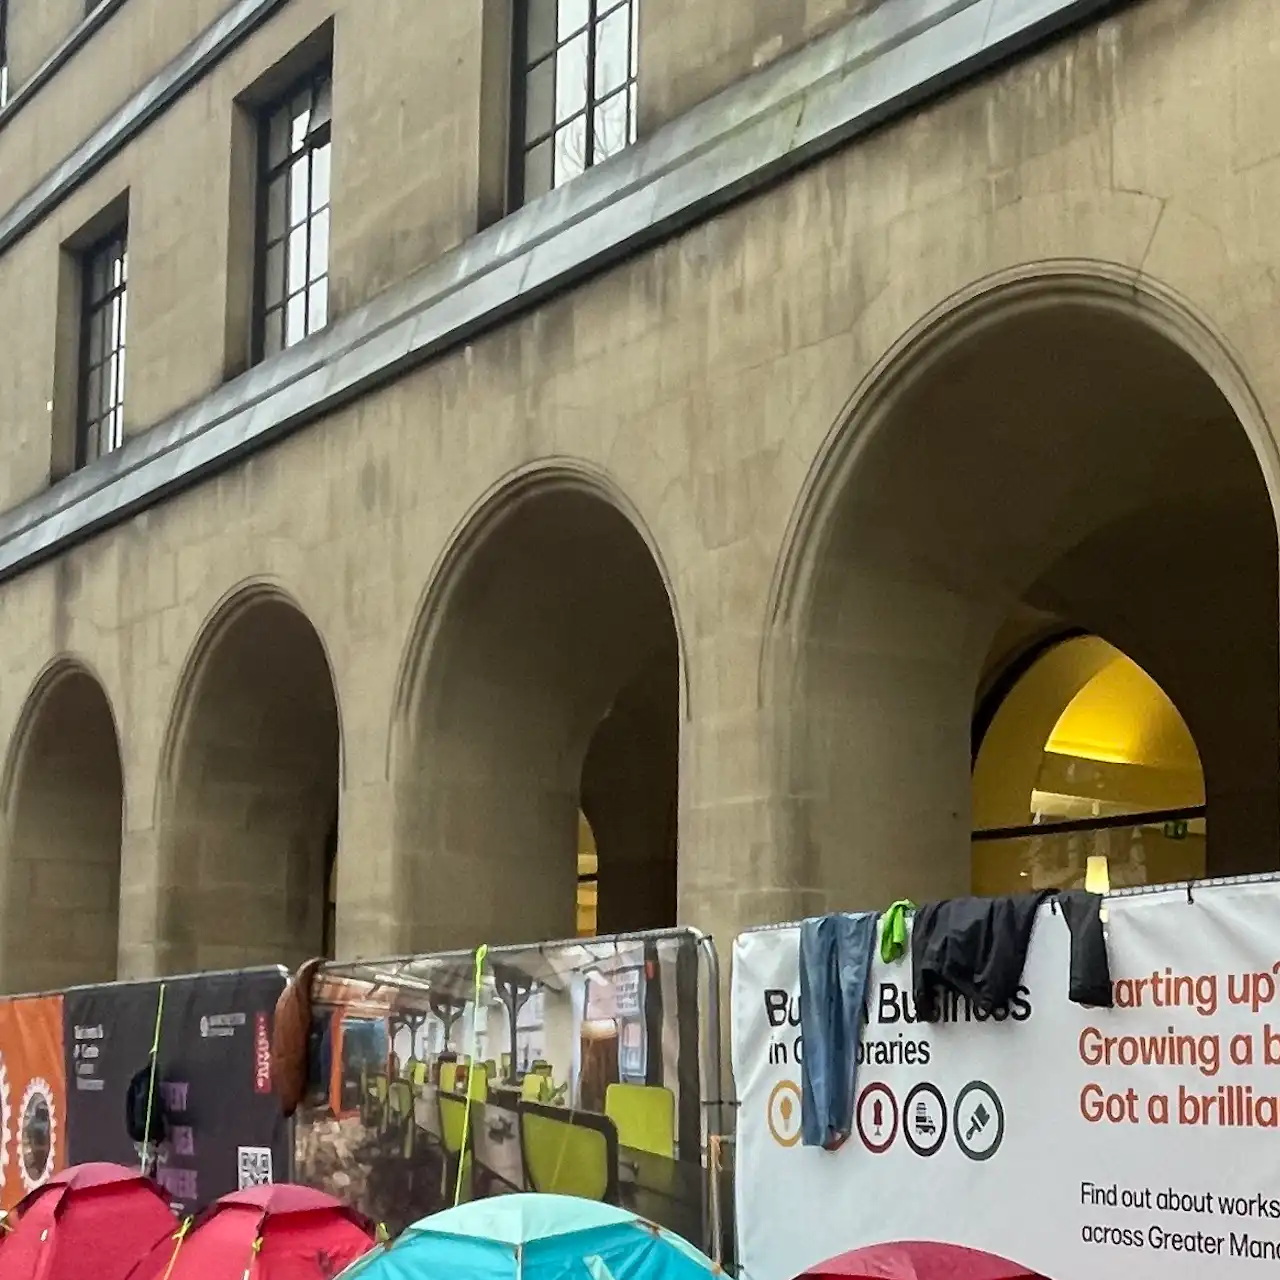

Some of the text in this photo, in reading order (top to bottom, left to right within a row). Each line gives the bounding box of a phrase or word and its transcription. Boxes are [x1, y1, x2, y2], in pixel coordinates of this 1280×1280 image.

[1111, 967, 1217, 1015] arting
[768, 1036, 788, 1065] in
[1079, 1026, 1221, 1076] Growing
[1230, 1034, 1253, 1065] a
[1080, 1083, 1139, 1123] Got
[1148, 1095, 1169, 1124] a
[1081, 1181, 1118, 1208] Find
[1121, 1188, 1153, 1210] out
[1156, 1187, 1215, 1214] about
[1081, 1226, 1144, 1248] across
[1148, 1225, 1226, 1256] Greater
